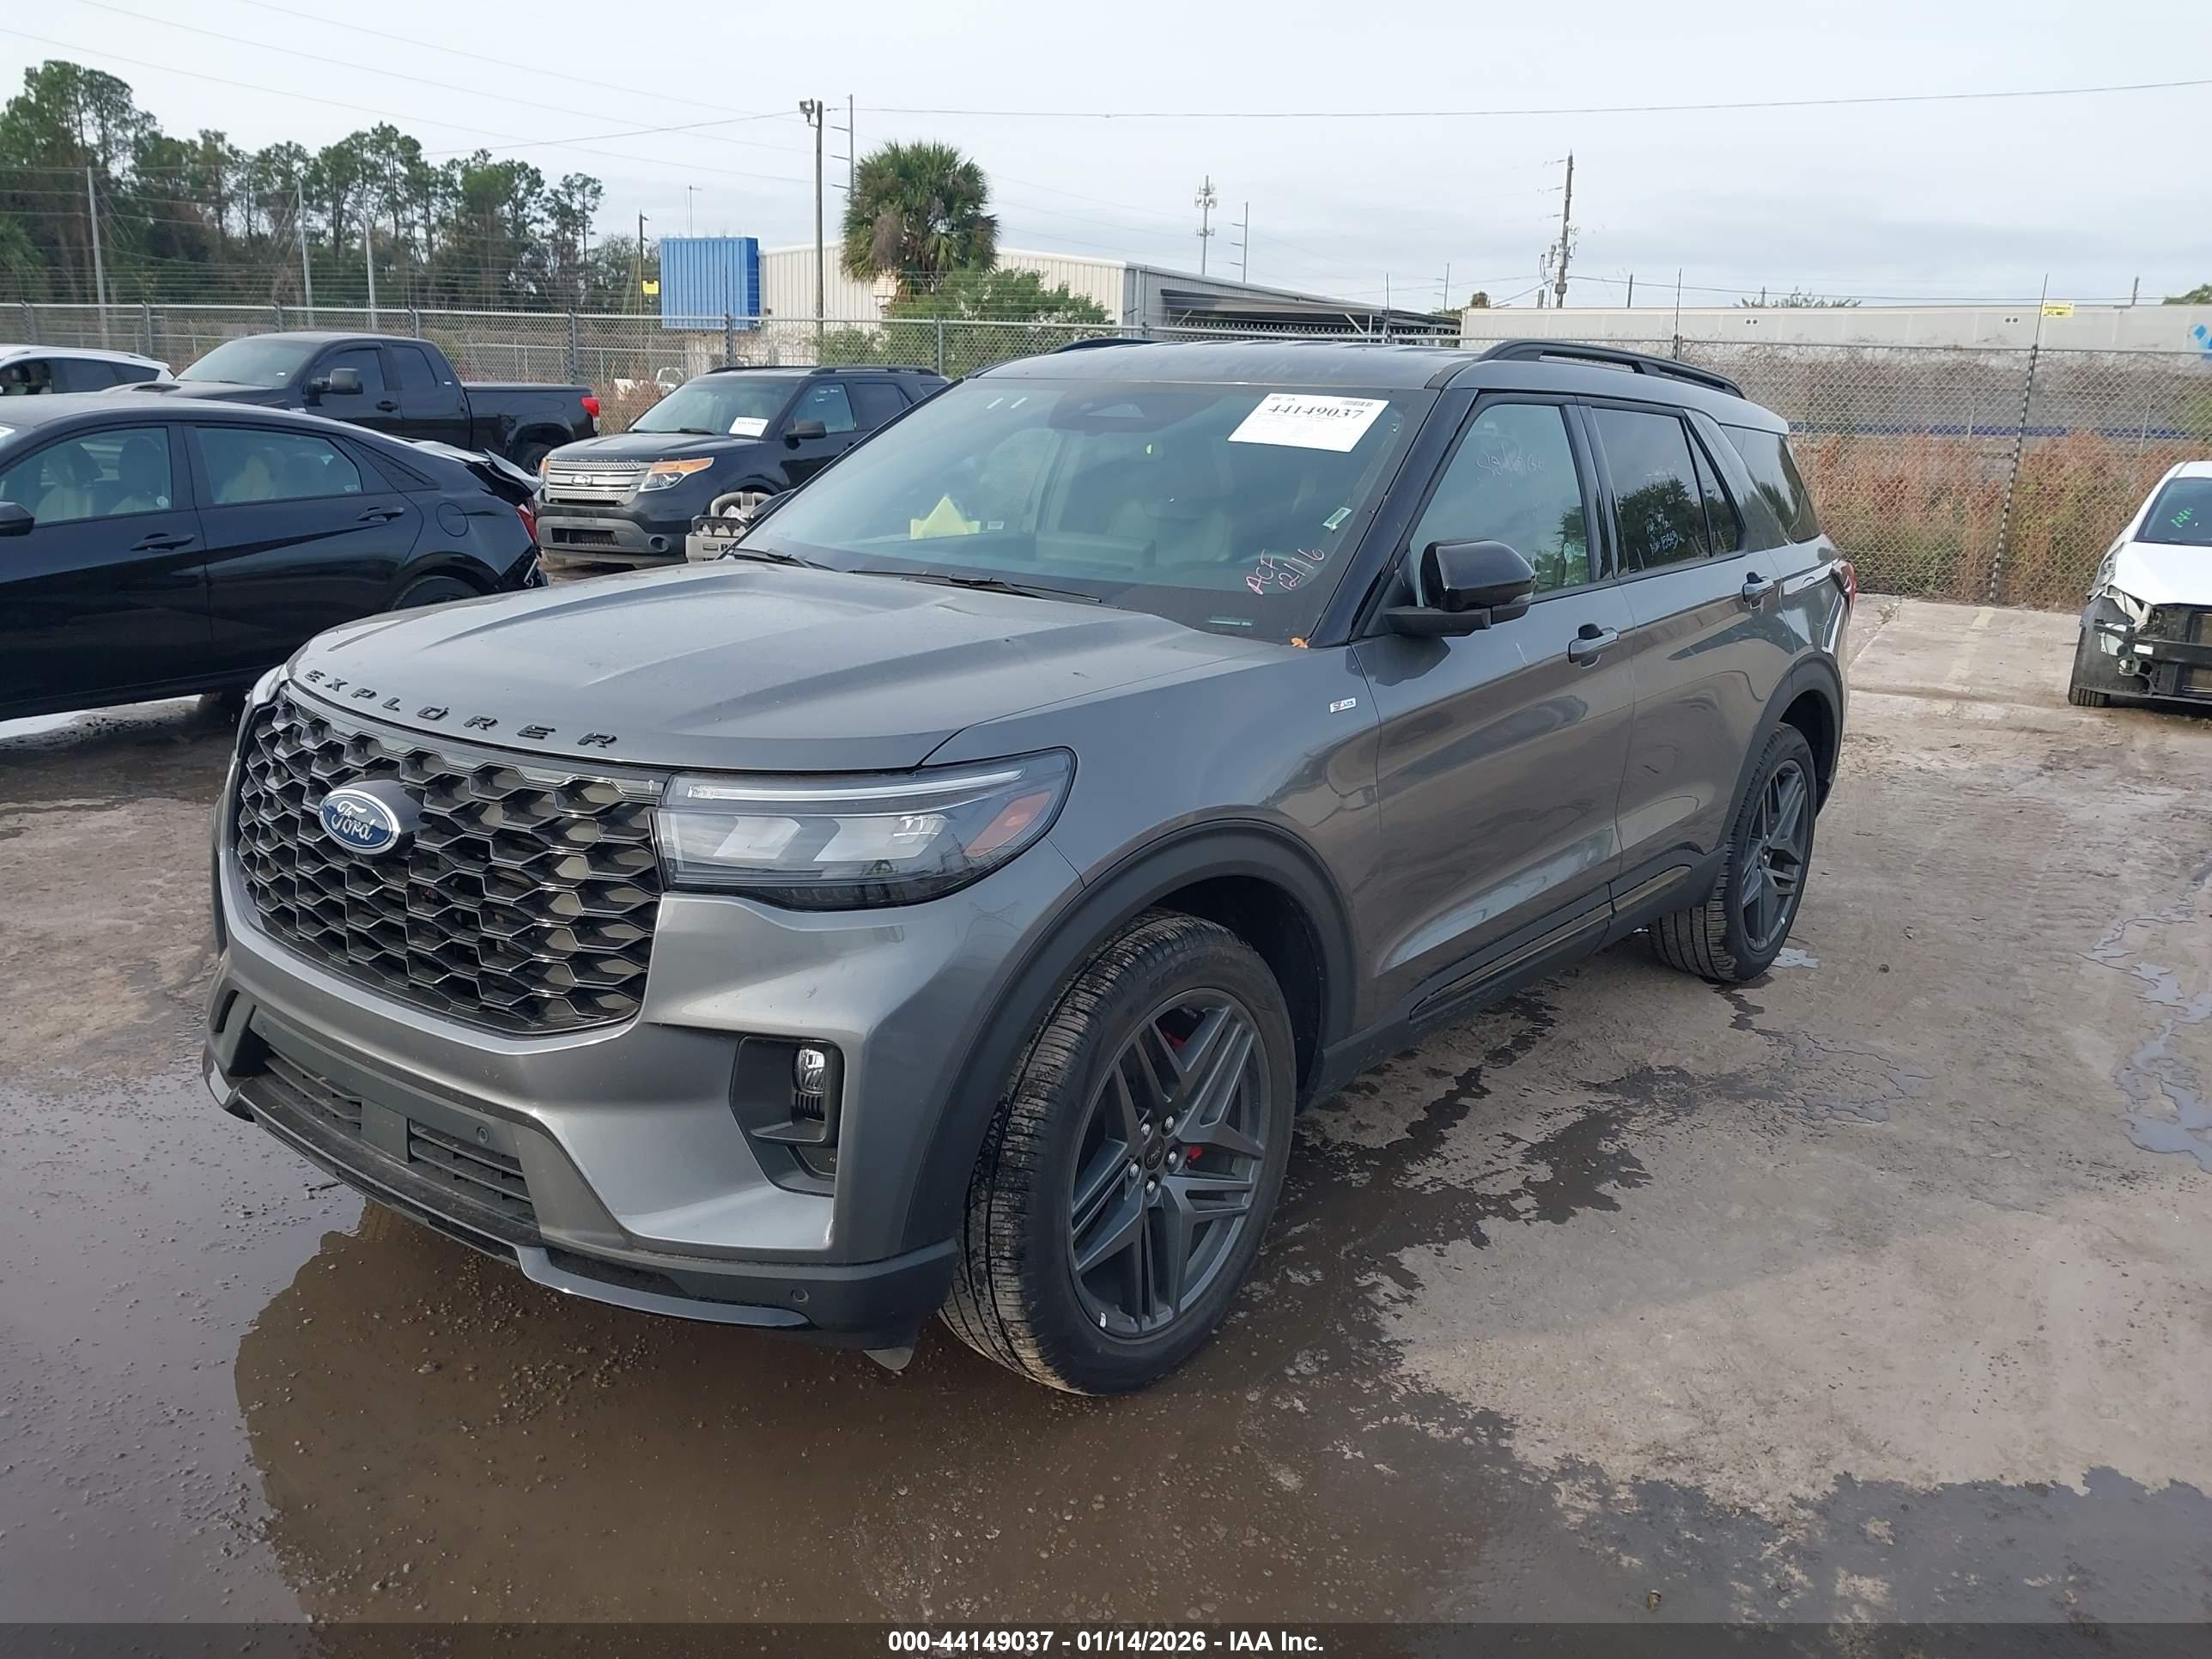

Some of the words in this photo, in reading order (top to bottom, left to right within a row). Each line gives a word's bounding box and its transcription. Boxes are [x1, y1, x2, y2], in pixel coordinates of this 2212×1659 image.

[1267, 404, 1365, 419] 44149037
[305, 669, 617, 749] EXPLORER
[331, 800, 376, 841] Ford
